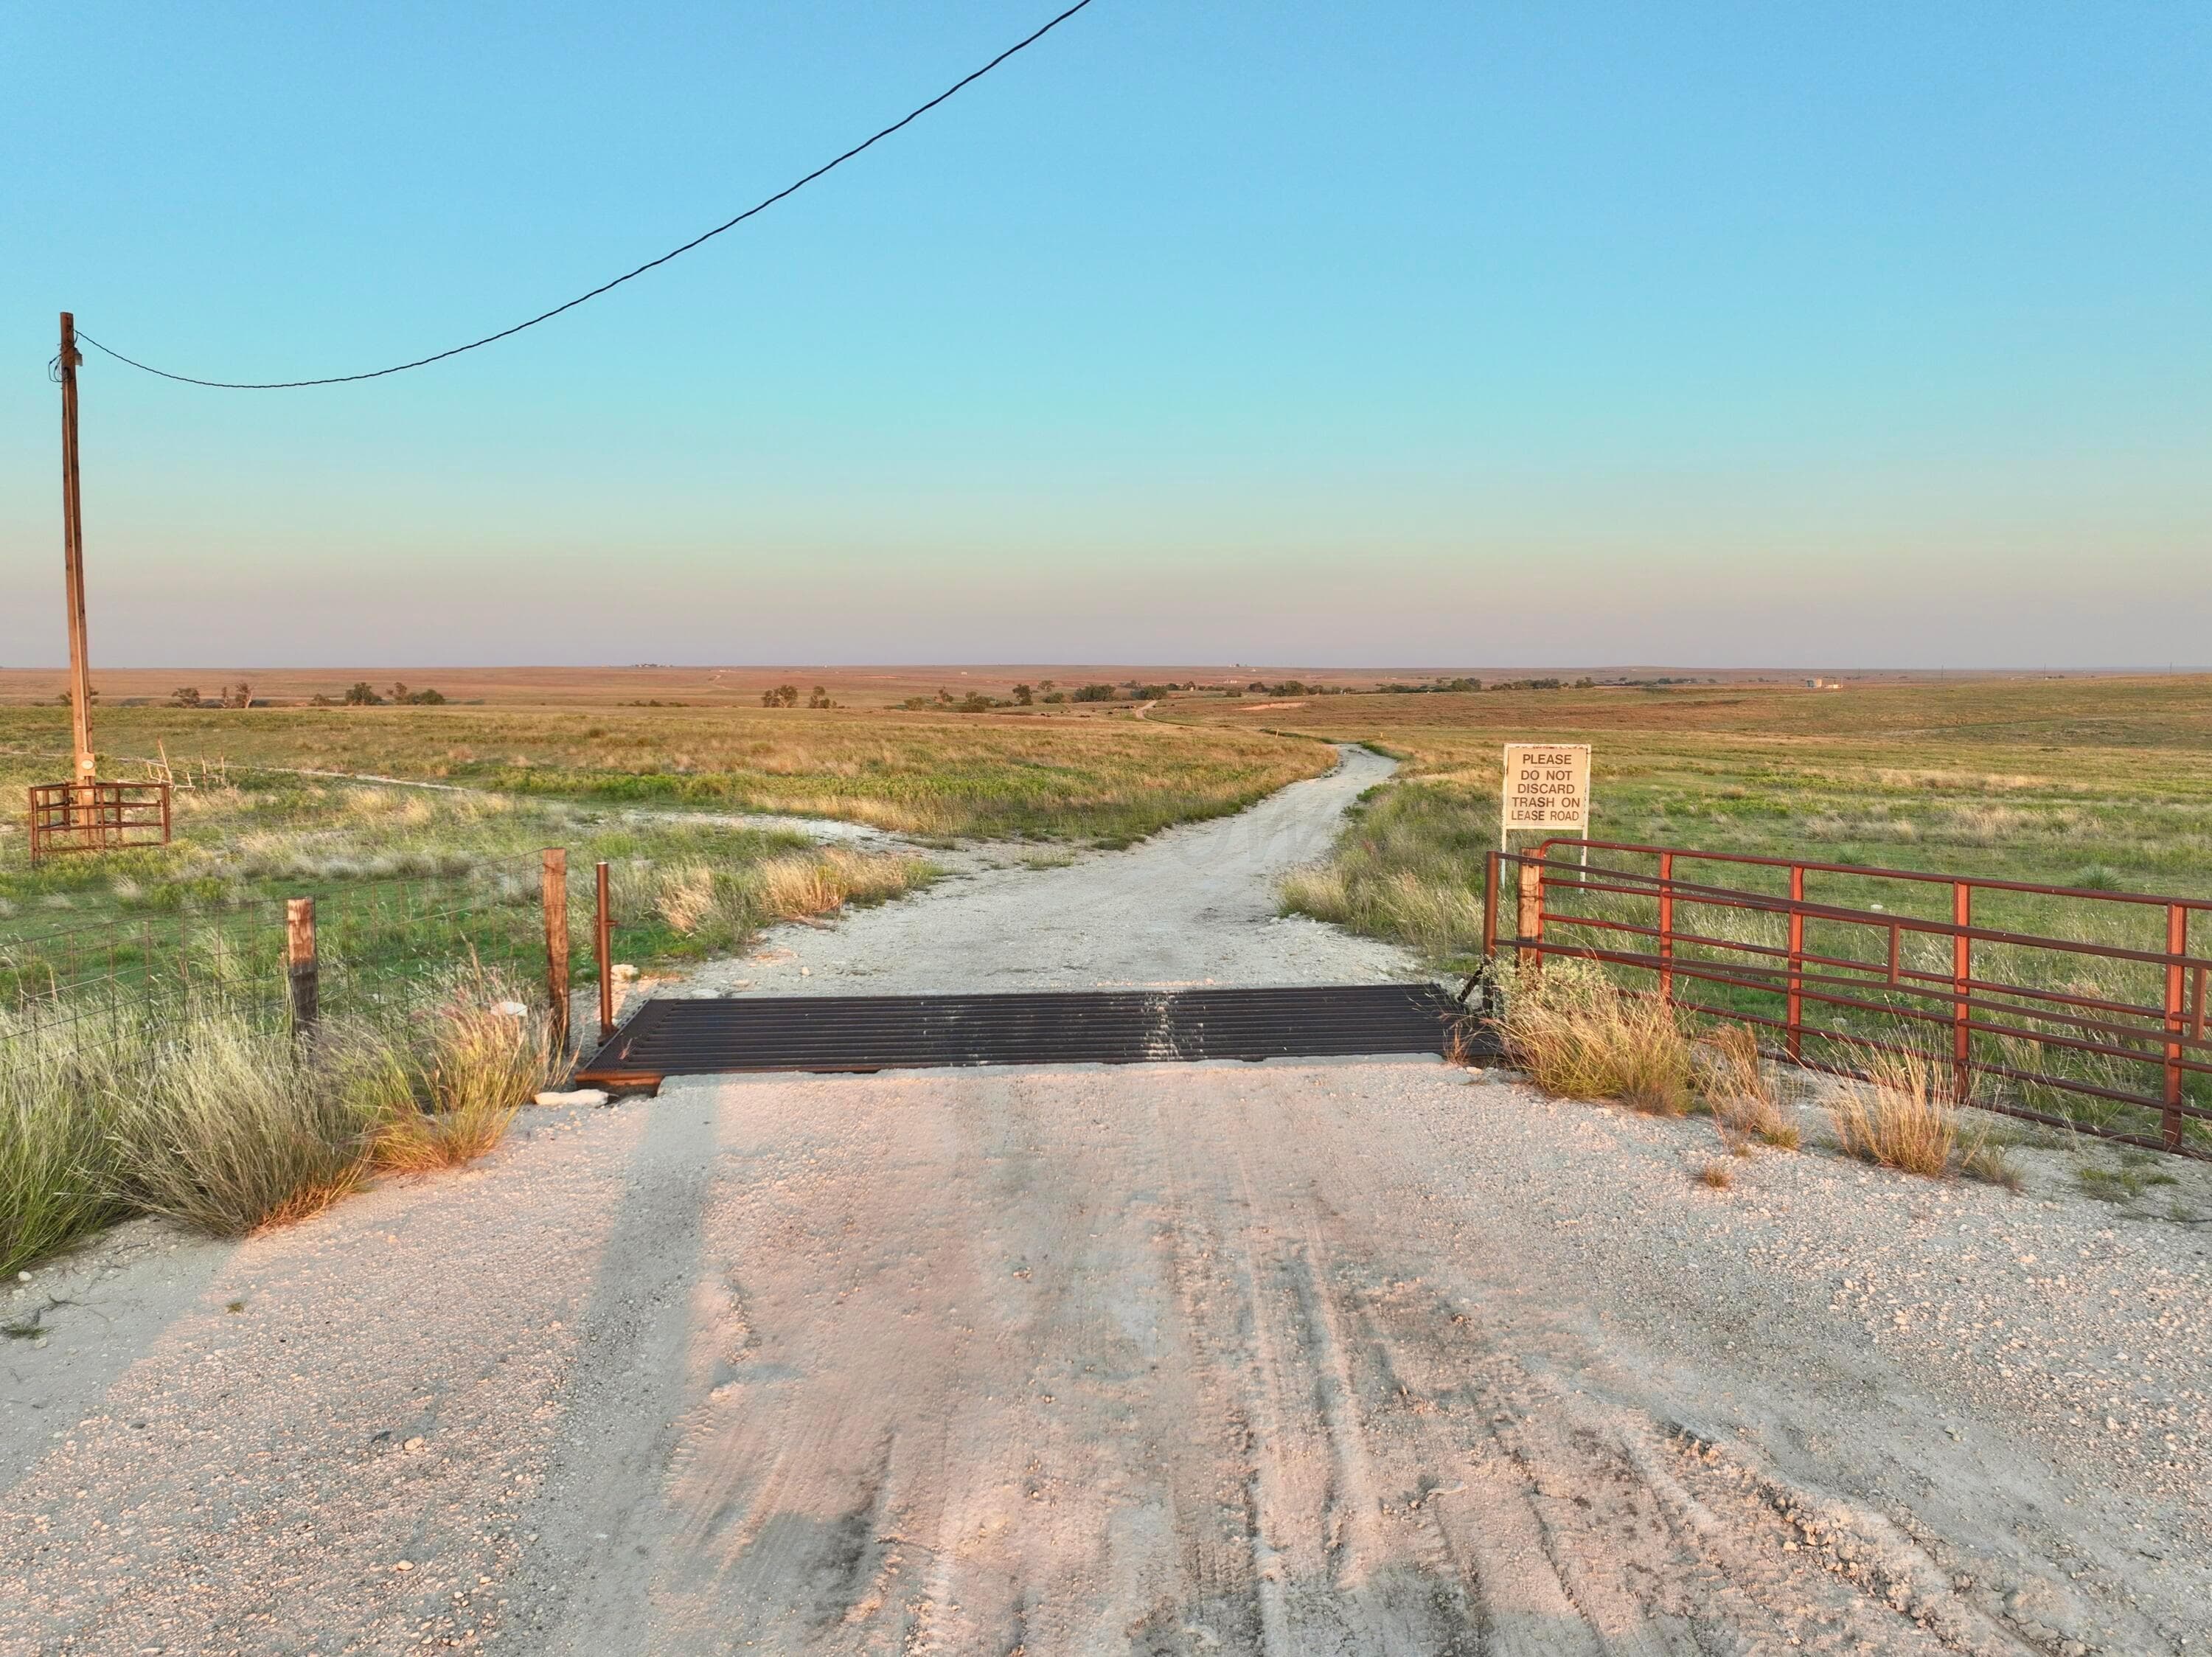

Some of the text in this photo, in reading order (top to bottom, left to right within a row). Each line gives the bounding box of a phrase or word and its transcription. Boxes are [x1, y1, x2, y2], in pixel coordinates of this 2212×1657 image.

[1523, 754, 1571, 764] PLEASE
[1521, 771, 1573, 780] DO NOT
[1518, 784, 1574, 793] DISCARD
[1512, 797, 1579, 807] TRASH ON
[1512, 810, 1579, 821] LEASE ROAD
